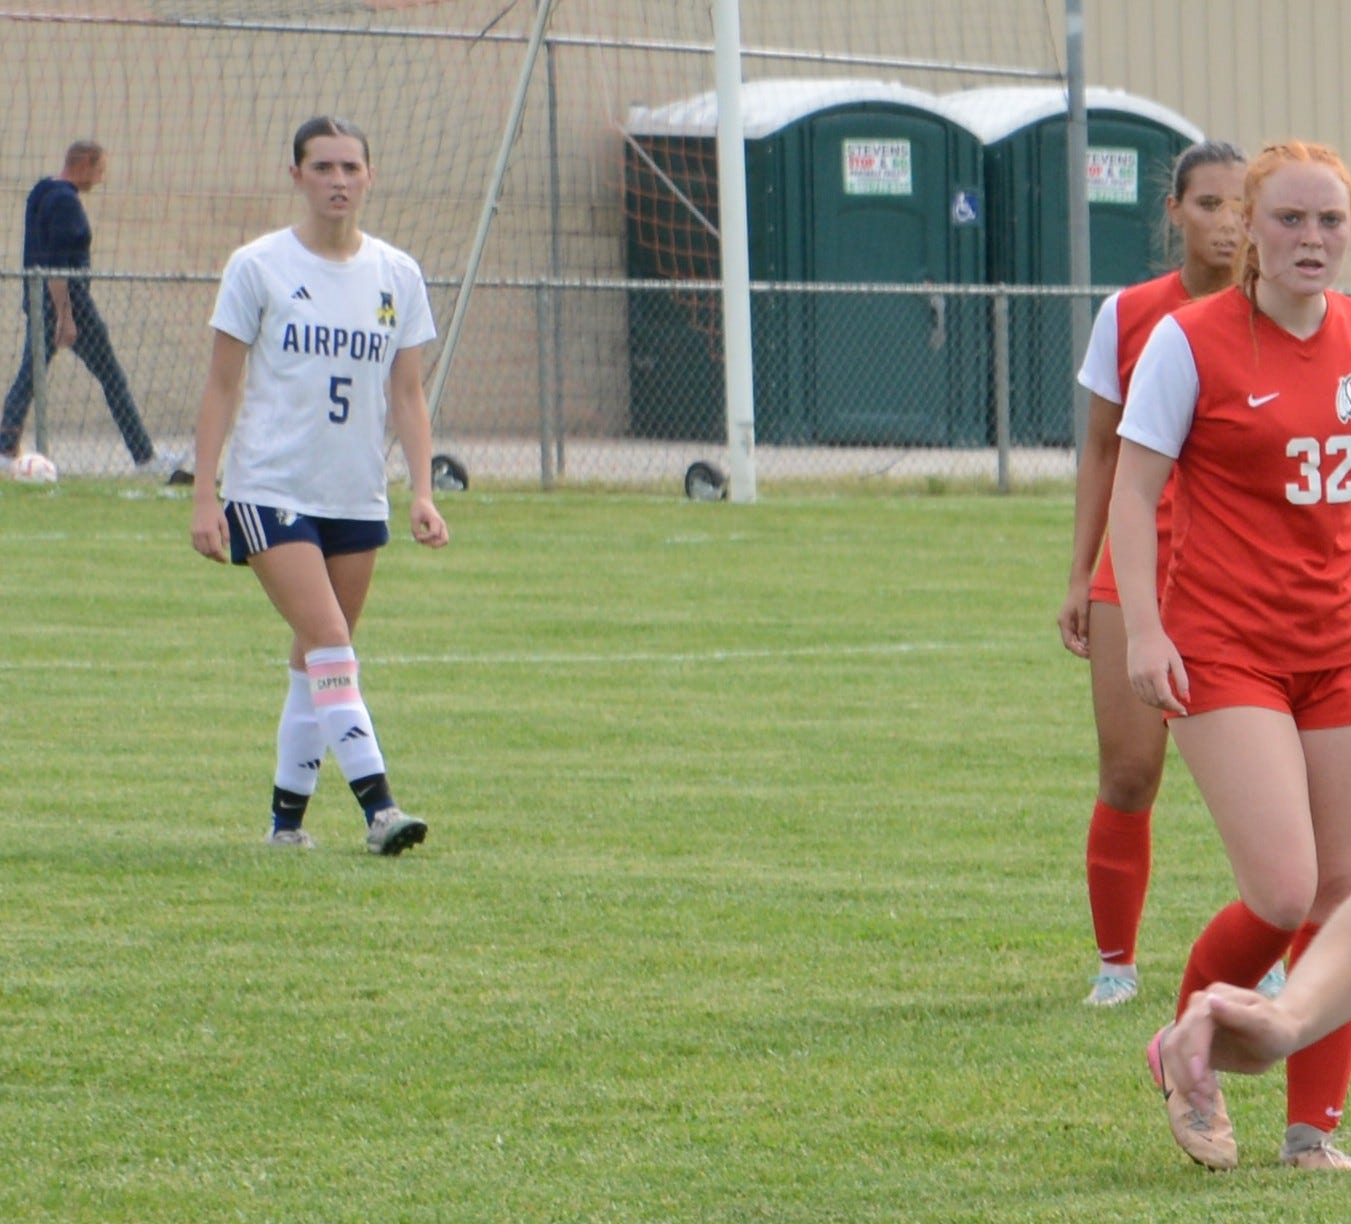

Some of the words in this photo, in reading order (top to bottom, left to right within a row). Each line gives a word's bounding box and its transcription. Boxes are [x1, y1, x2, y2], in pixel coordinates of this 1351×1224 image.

[848, 144, 909, 156] STEVENS
[848, 155, 876, 169] STOP
[328, 376, 353, 424] 5
